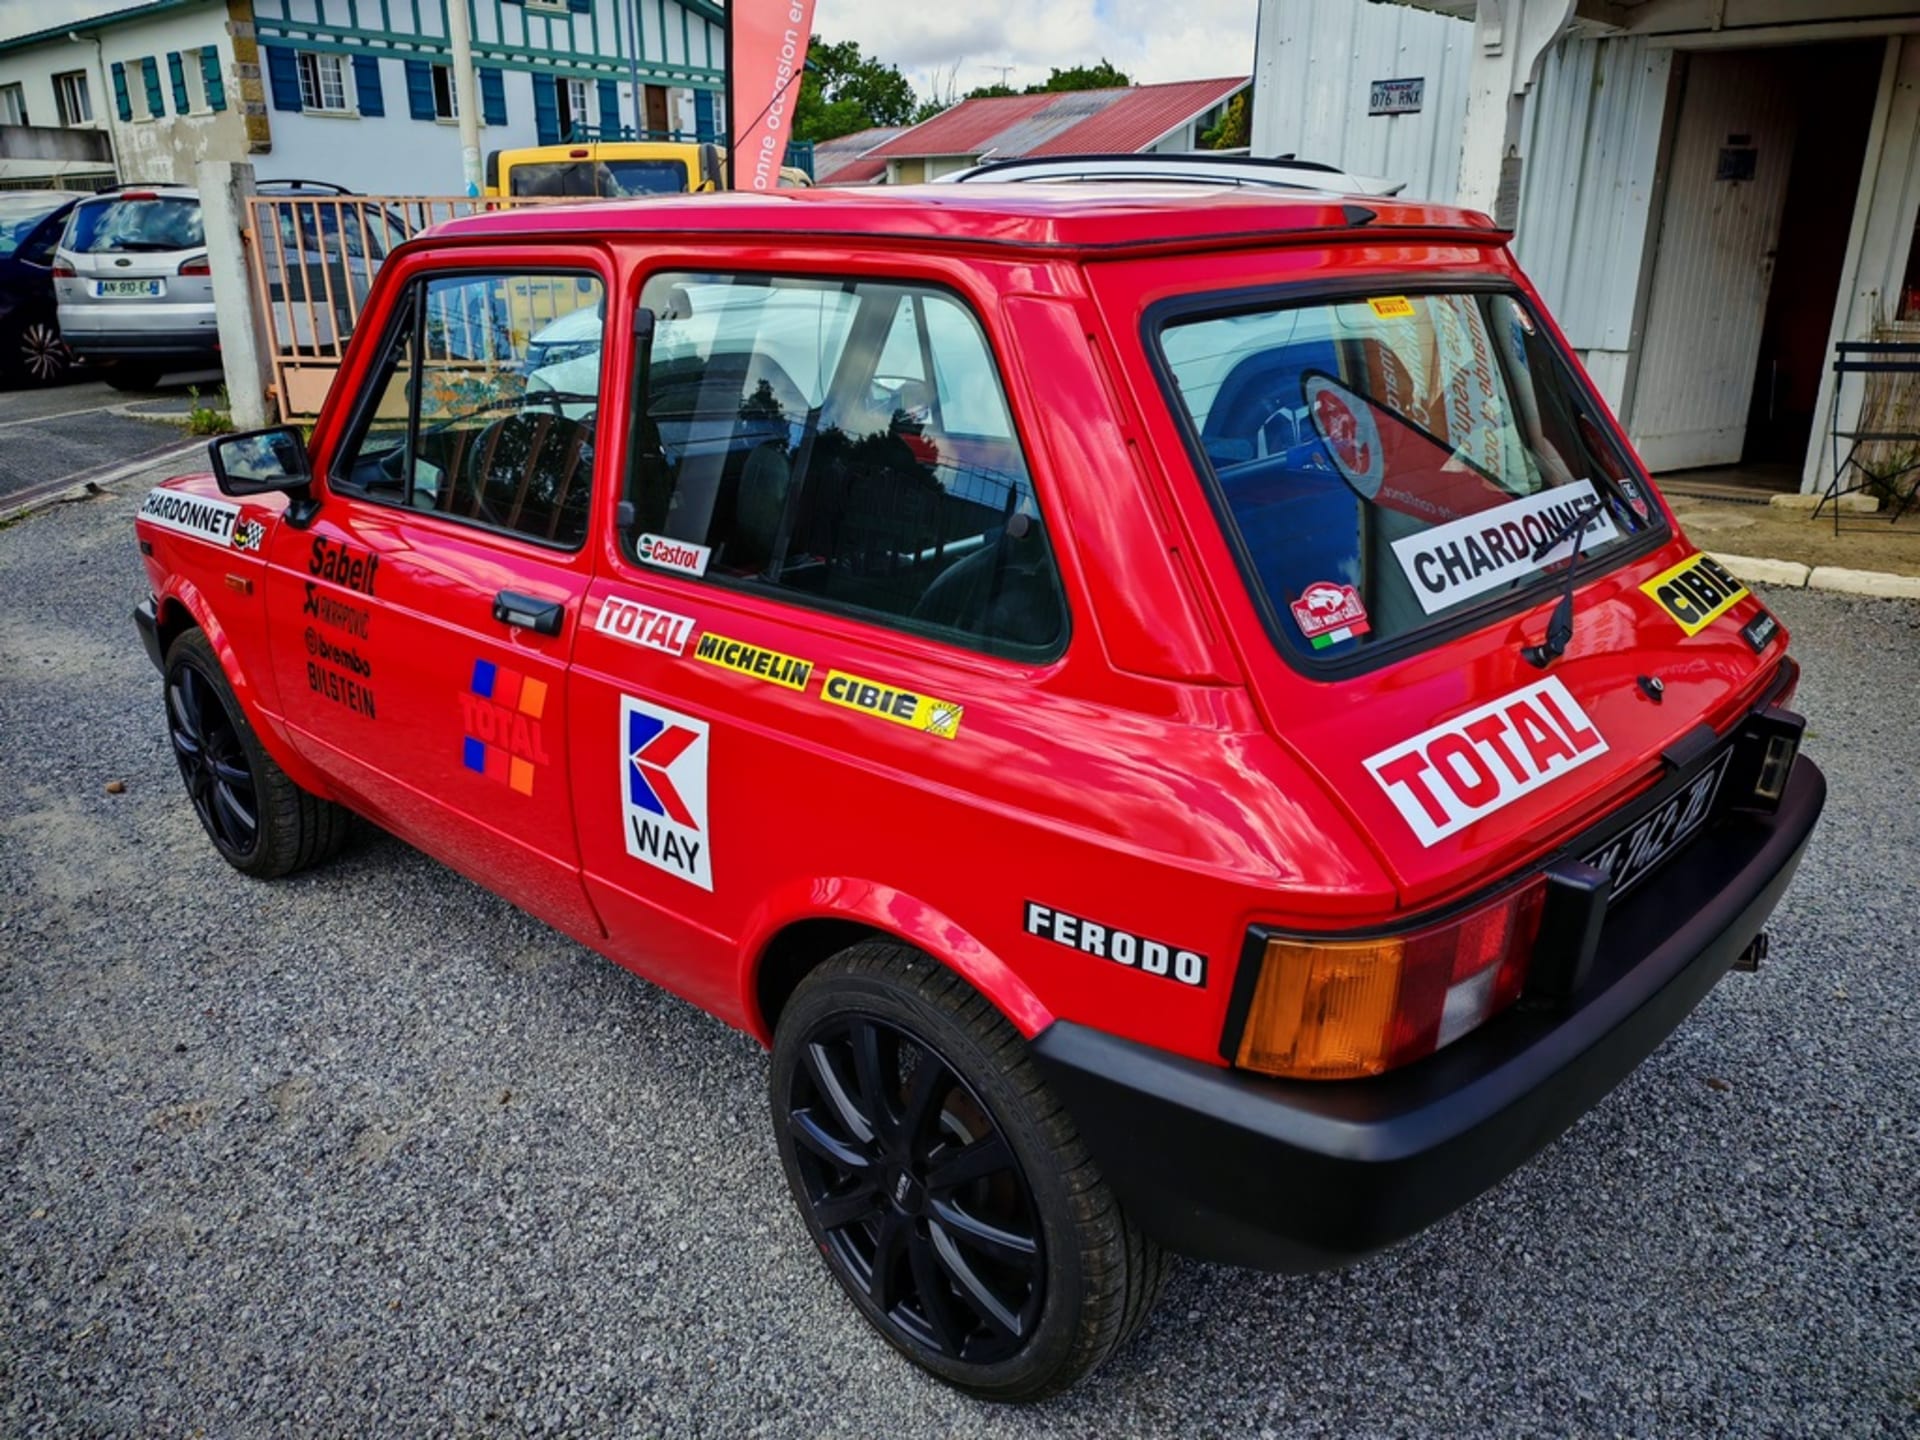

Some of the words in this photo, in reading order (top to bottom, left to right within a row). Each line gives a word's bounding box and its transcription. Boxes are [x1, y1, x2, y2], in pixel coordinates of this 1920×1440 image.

[767, 29, 798, 130] occasion
[1371, 92, 1392, 107] 076
[1398, 90, 1421, 105] RNX
[309, 536, 379, 596] Sabelt
[652, 540, 699, 569] Castrol
[602, 602, 684, 652] TOTAL
[319, 636, 371, 678] brembo
[697, 635, 810, 687] MICHELIN
[307, 661, 376, 720] BILSTEIN
[459, 691, 549, 766] TOTAL
[1376, 691, 1601, 829] TOTAL
[631, 815, 700, 874] WAY
[1028, 903, 1202, 985] FERODO
